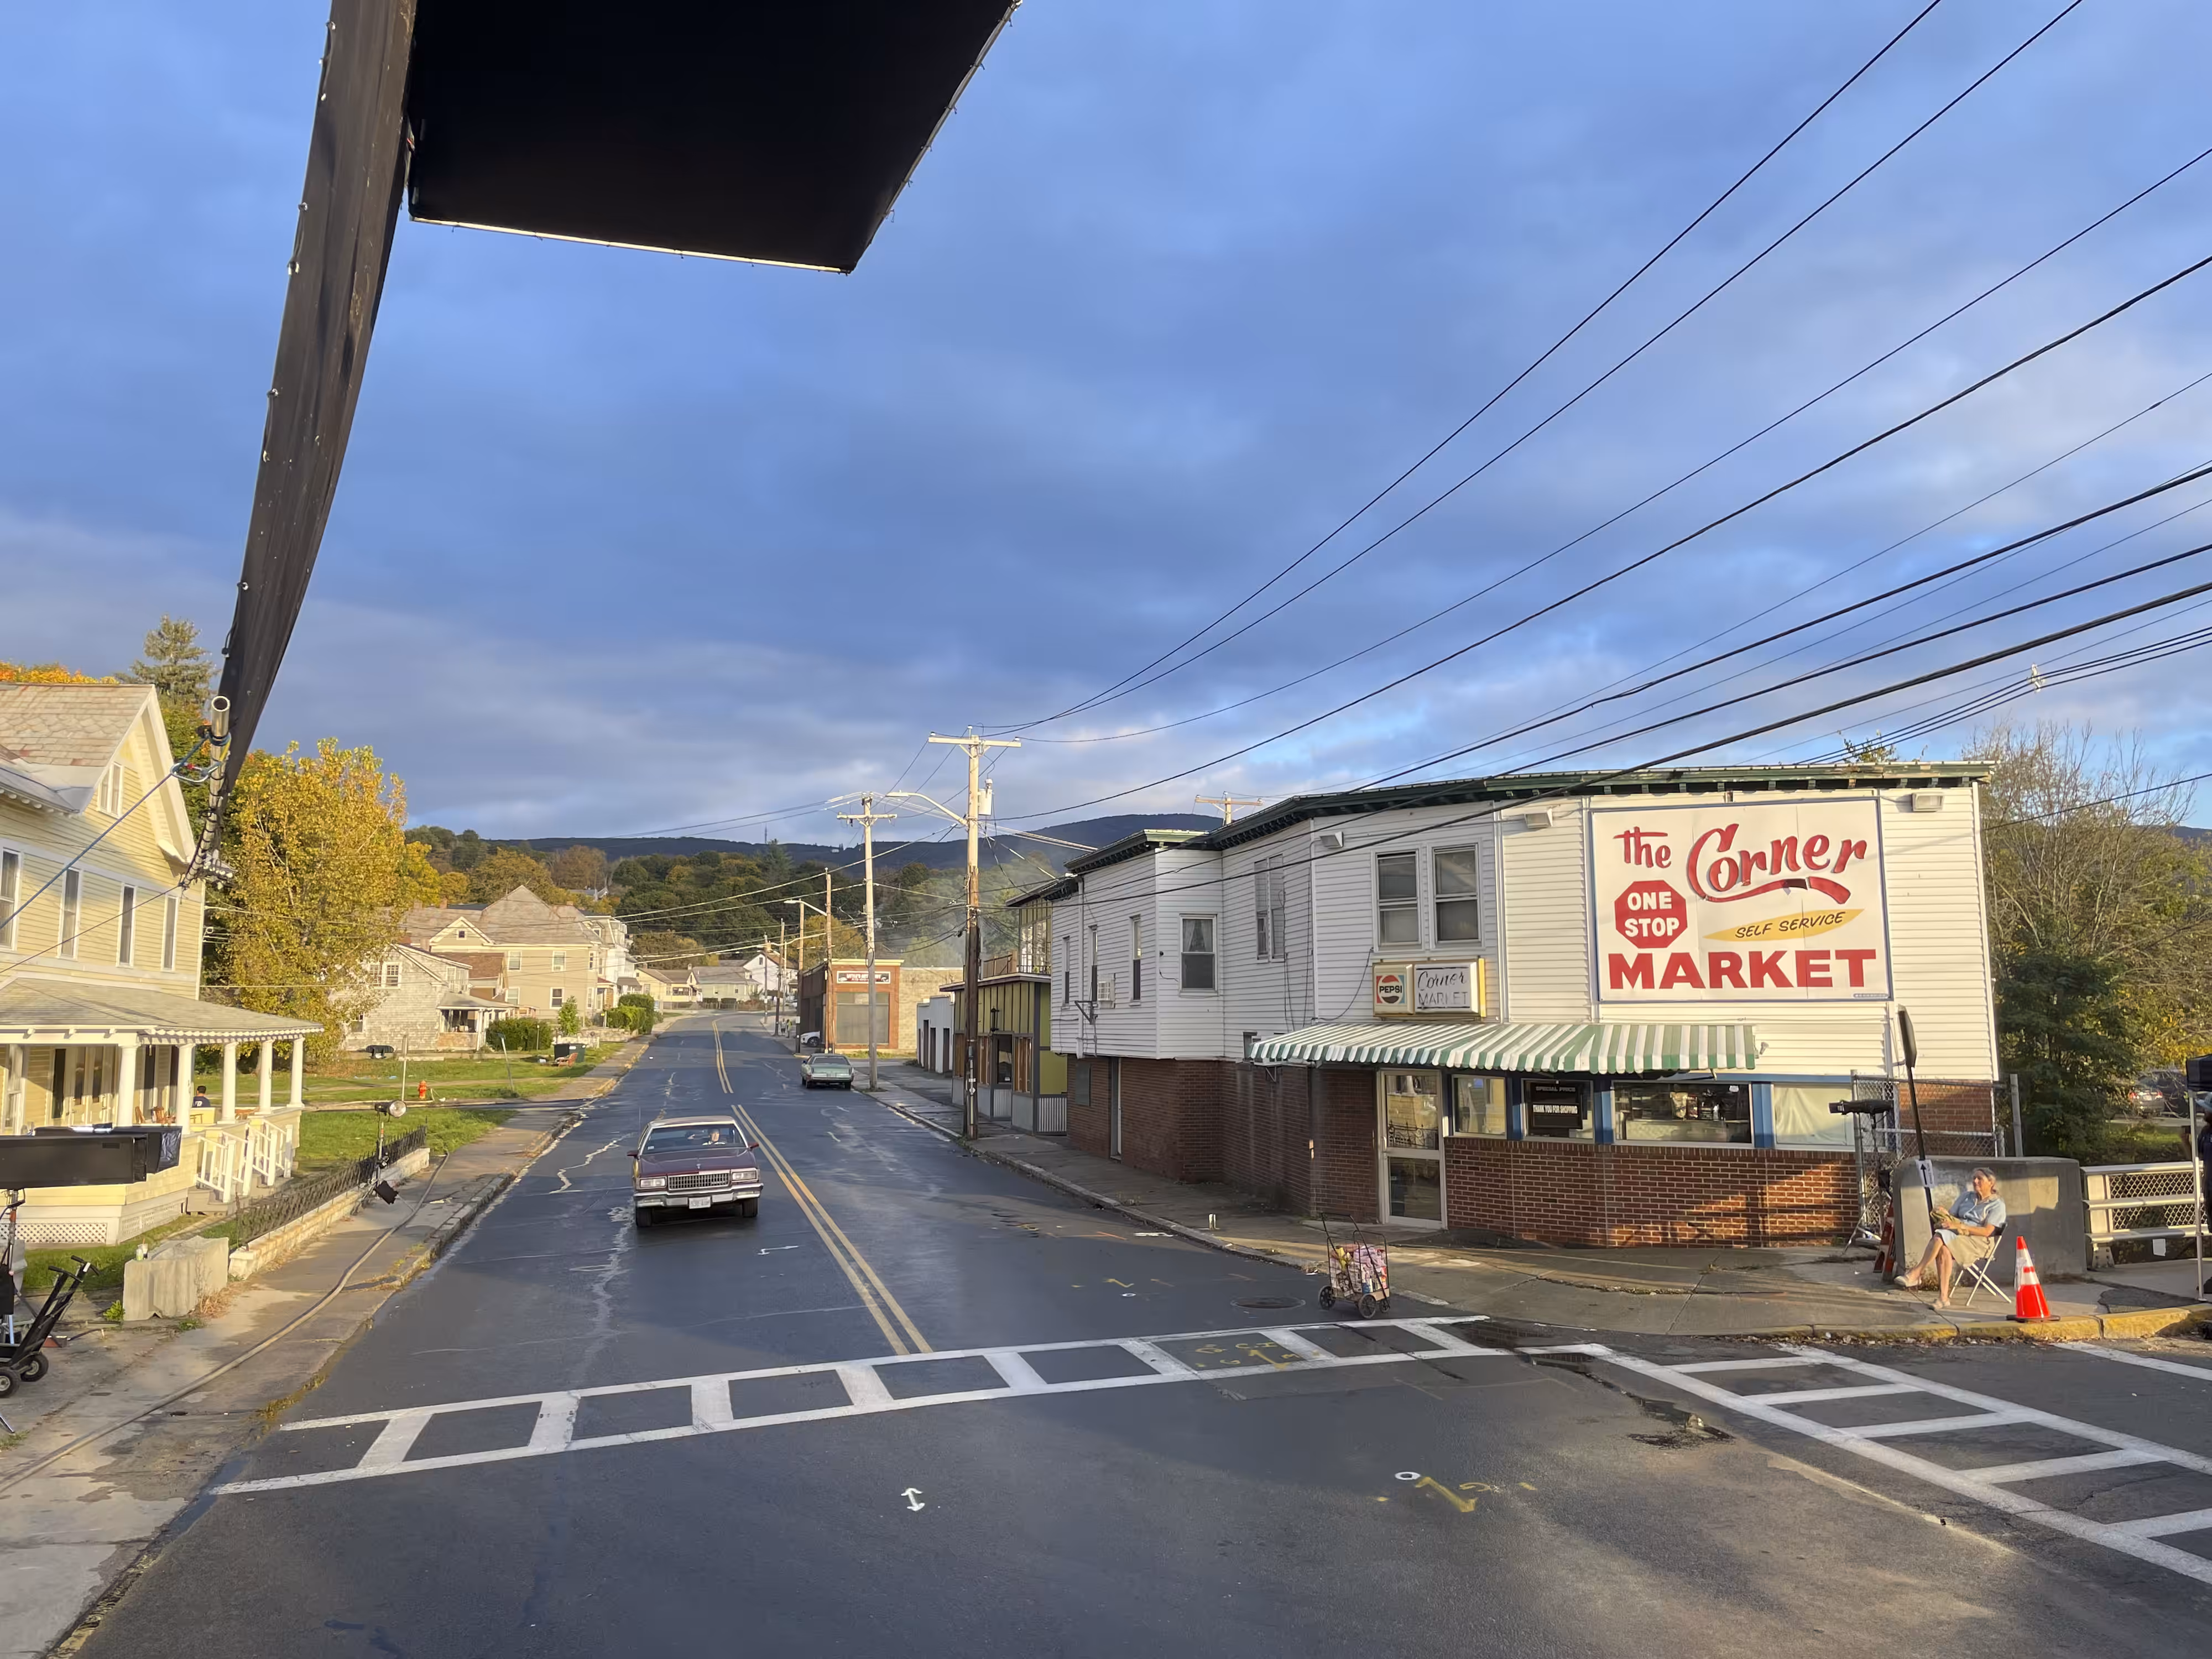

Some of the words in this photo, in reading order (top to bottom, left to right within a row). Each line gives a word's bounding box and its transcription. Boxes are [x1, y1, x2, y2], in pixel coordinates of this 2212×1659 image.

[1613, 826, 1672, 868] the
[1686, 823, 1867, 904] Corner
[1627, 891, 1672, 911] ONE
[1624, 917, 1680, 938] STOP
[1735, 923, 1772, 938] SELF
[1778, 911, 1846, 932] SERVICE
[1608, 949, 1877, 990] MARKET
[1379, 985, 1402, 994] PEPSI
[1560, 1105, 1578, 1114] SHOPPING
